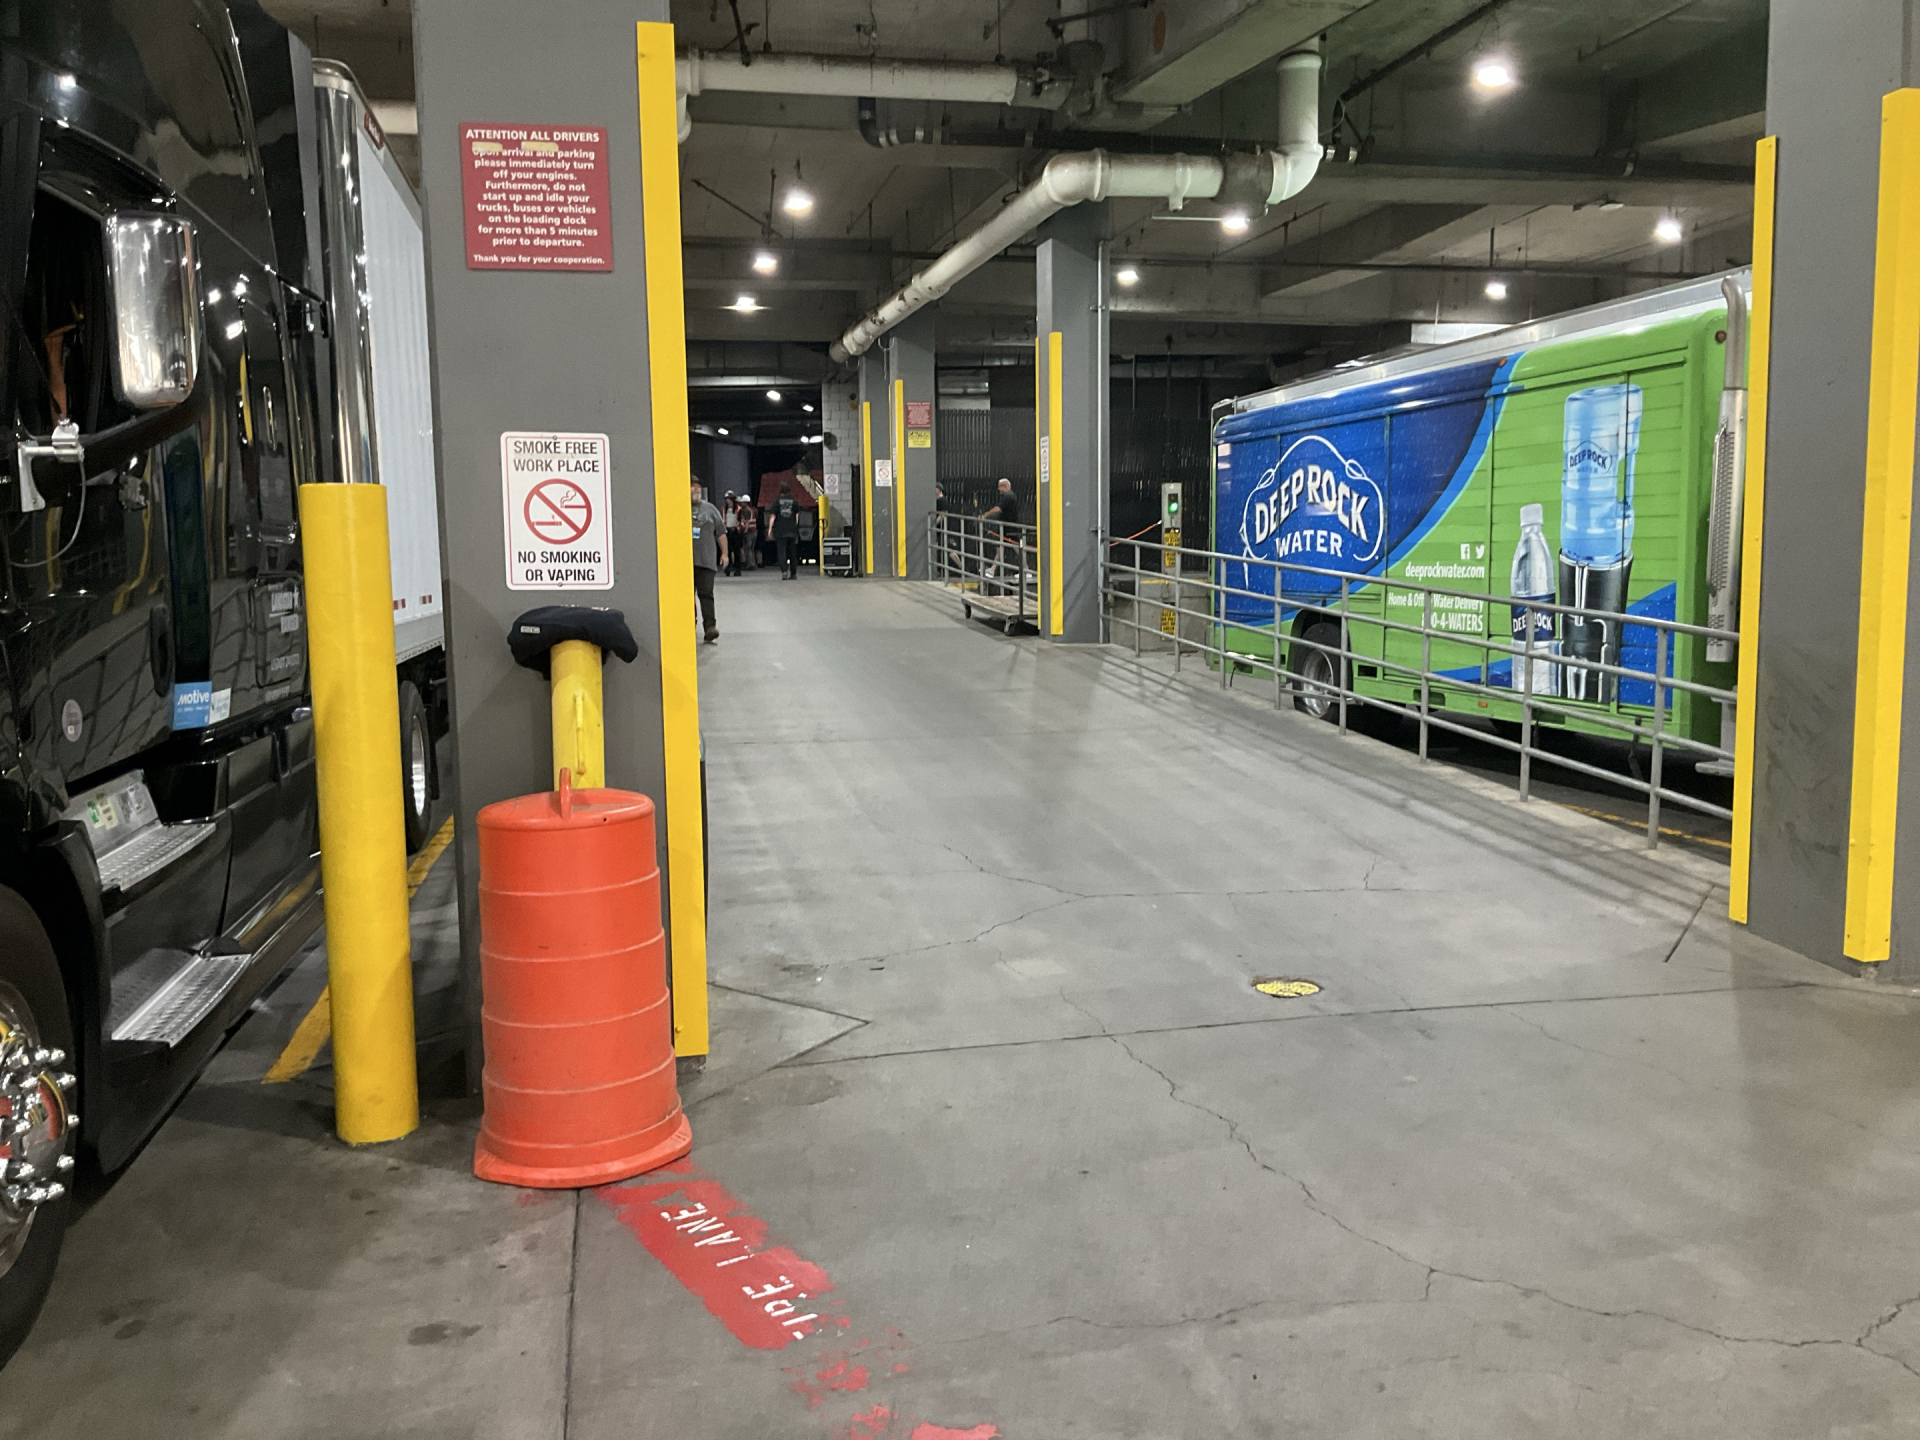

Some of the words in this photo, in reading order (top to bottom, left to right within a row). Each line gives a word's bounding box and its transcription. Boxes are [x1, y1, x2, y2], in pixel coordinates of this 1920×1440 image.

[466, 129, 527, 140] ATTENTION
[530, 131, 550, 141] ALL
[553, 132, 600, 142] DRIVERS
[558, 148, 595, 161] parking
[474, 158, 507, 169] please
[509, 158, 571, 171] immediately
[573, 161, 595, 170] turn
[493, 169, 508, 179] off
[511, 171, 533, 180] your
[536, 171, 577, 181] engines.
[485, 181, 550, 191] Furthermore,
[553, 182, 566, 191] do
[568, 183, 586, 191] not
[483, 192, 507, 201] start
[509, 194, 522, 203] up
[525, 193, 543, 202] and
[546, 193, 565, 202] idle
[567, 195, 590, 205] your
[477, 203, 511, 213] trucks,
[513, 203, 542, 213] buses
[544, 205, 556, 213] or
[557, 204, 597, 214] vehicles
[488, 215, 501, 223] on
[504, 214, 521, 223] the
[523, 214, 561, 226] loading
[563, 216, 587, 224] dock
[478, 225, 493, 234] for
[495, 226, 521, 235] more
[524, 226, 547, 235] than
[550, 227, 556, 235] 5
[558, 227, 598, 236] minutes
[492, 236, 517, 247] prior
[519, 237, 530, 246] to
[533, 237, 585, 248] departure.
[473, 254, 499, 262] Thank
[501, 256, 516, 264] you
[518, 255, 531, 263] for
[533, 256, 552, 264] your
[553, 256, 605, 265] cooperation.
[514, 441, 561, 454] SMOKE
[565, 442, 598, 455] FREE
[514, 459, 553, 472] WORK
[558, 460, 600, 473] PLACE
[1255, 468, 1304, 545] DEEP
[1307, 464, 1369, 543] ROCK
[1275, 529, 1343, 558] WATER
[518, 550, 536, 563] NO
[540, 551, 601, 564] SMOKING
[525, 569, 543, 581] OR
[547, 569, 595, 581] VAPING
[1405, 561, 1485, 581] deeprockwater.com
[1388, 592, 1406, 606] Home
[1407, 593, 1413, 606] &
[1434, 594, 1455, 609] Water
[1455, 597, 1484, 613] Delivery
[1534, 612, 1553, 631] OCK
